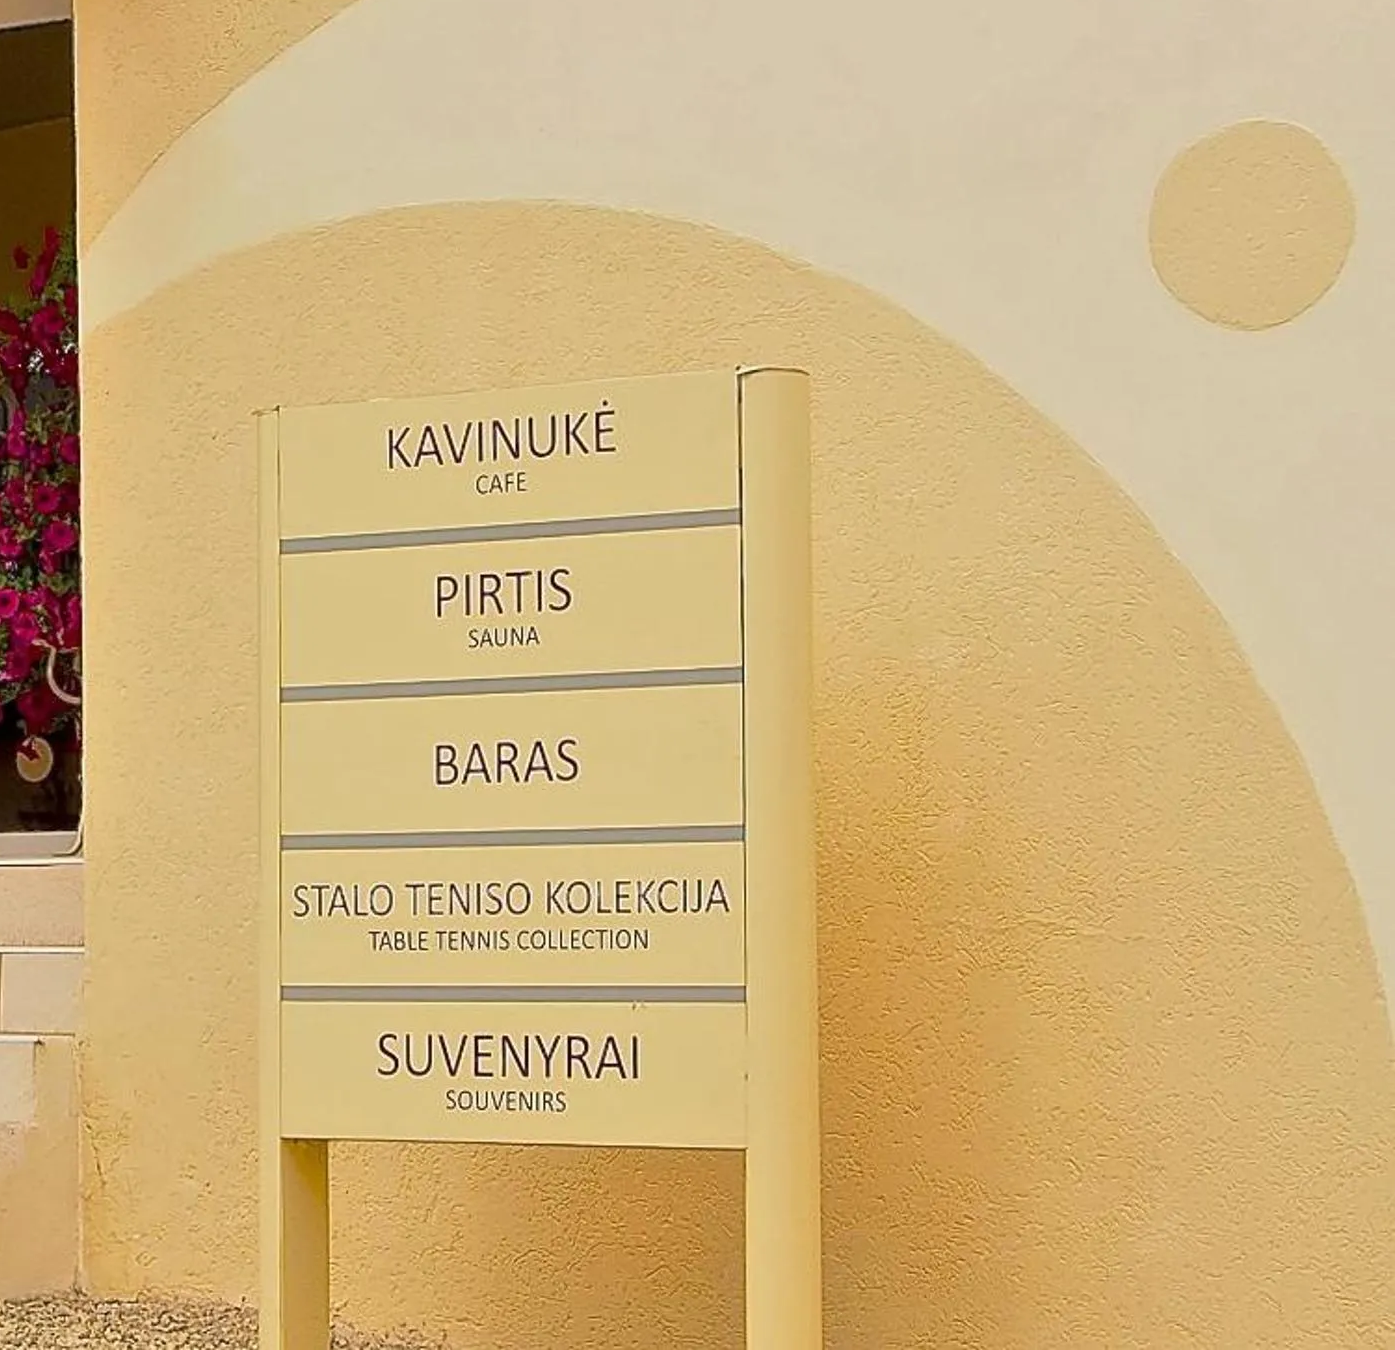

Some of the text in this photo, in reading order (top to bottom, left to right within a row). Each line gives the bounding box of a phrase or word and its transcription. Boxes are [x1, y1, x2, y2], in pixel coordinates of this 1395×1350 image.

[387, 400, 617, 470] KAVINUKĖ
[475, 471, 527, 495] CAFE
[435, 568, 573, 618] PIRTIS
[468, 626, 541, 648] SAUNA
[435, 739, 579, 785] BARAS
[293, 879, 730, 918] STALO TENISO KOLEKCIJA
[368, 929, 649, 951] TABLE TENNIS COLLECTION
[376, 1033, 640, 1080] SUVENYRAI
[445, 1089, 567, 1113] SOUVENIRS
